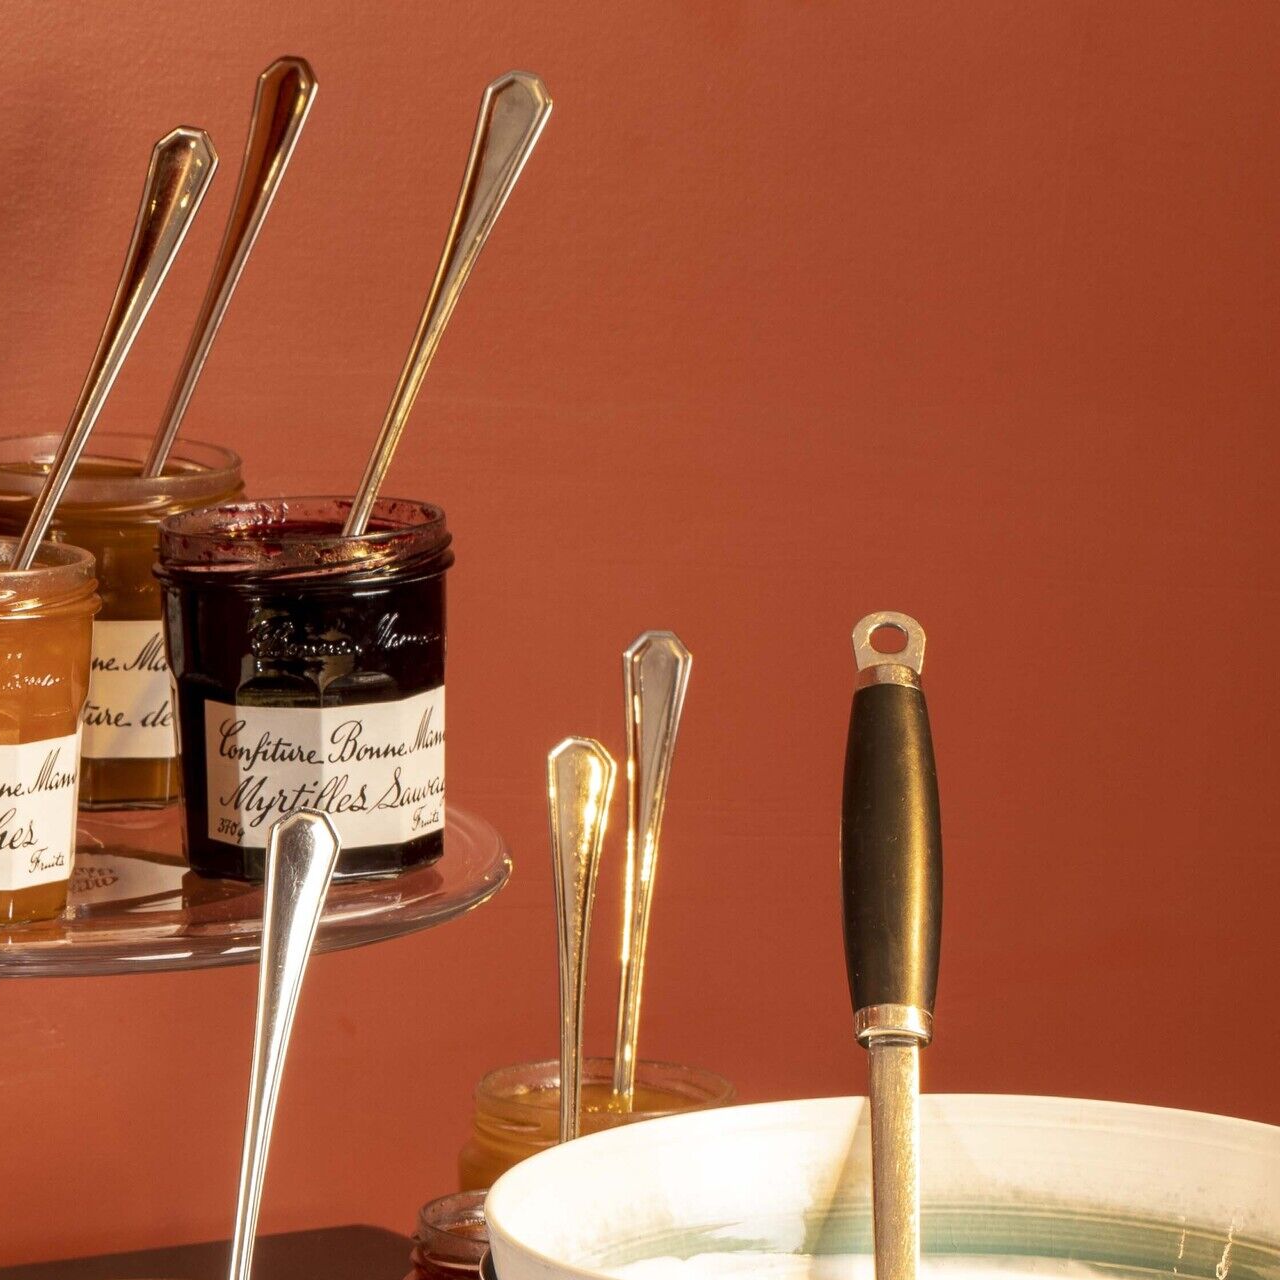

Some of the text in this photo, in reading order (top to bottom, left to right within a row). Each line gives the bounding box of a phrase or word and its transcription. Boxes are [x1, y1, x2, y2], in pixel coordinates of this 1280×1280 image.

[218, 705, 446, 772] Confiture Bonne Mam
[28, 746, 78, 795] Mam
[219, 774, 369, 829] Myrtilles
[28, 847, 65, 874] Fruits
